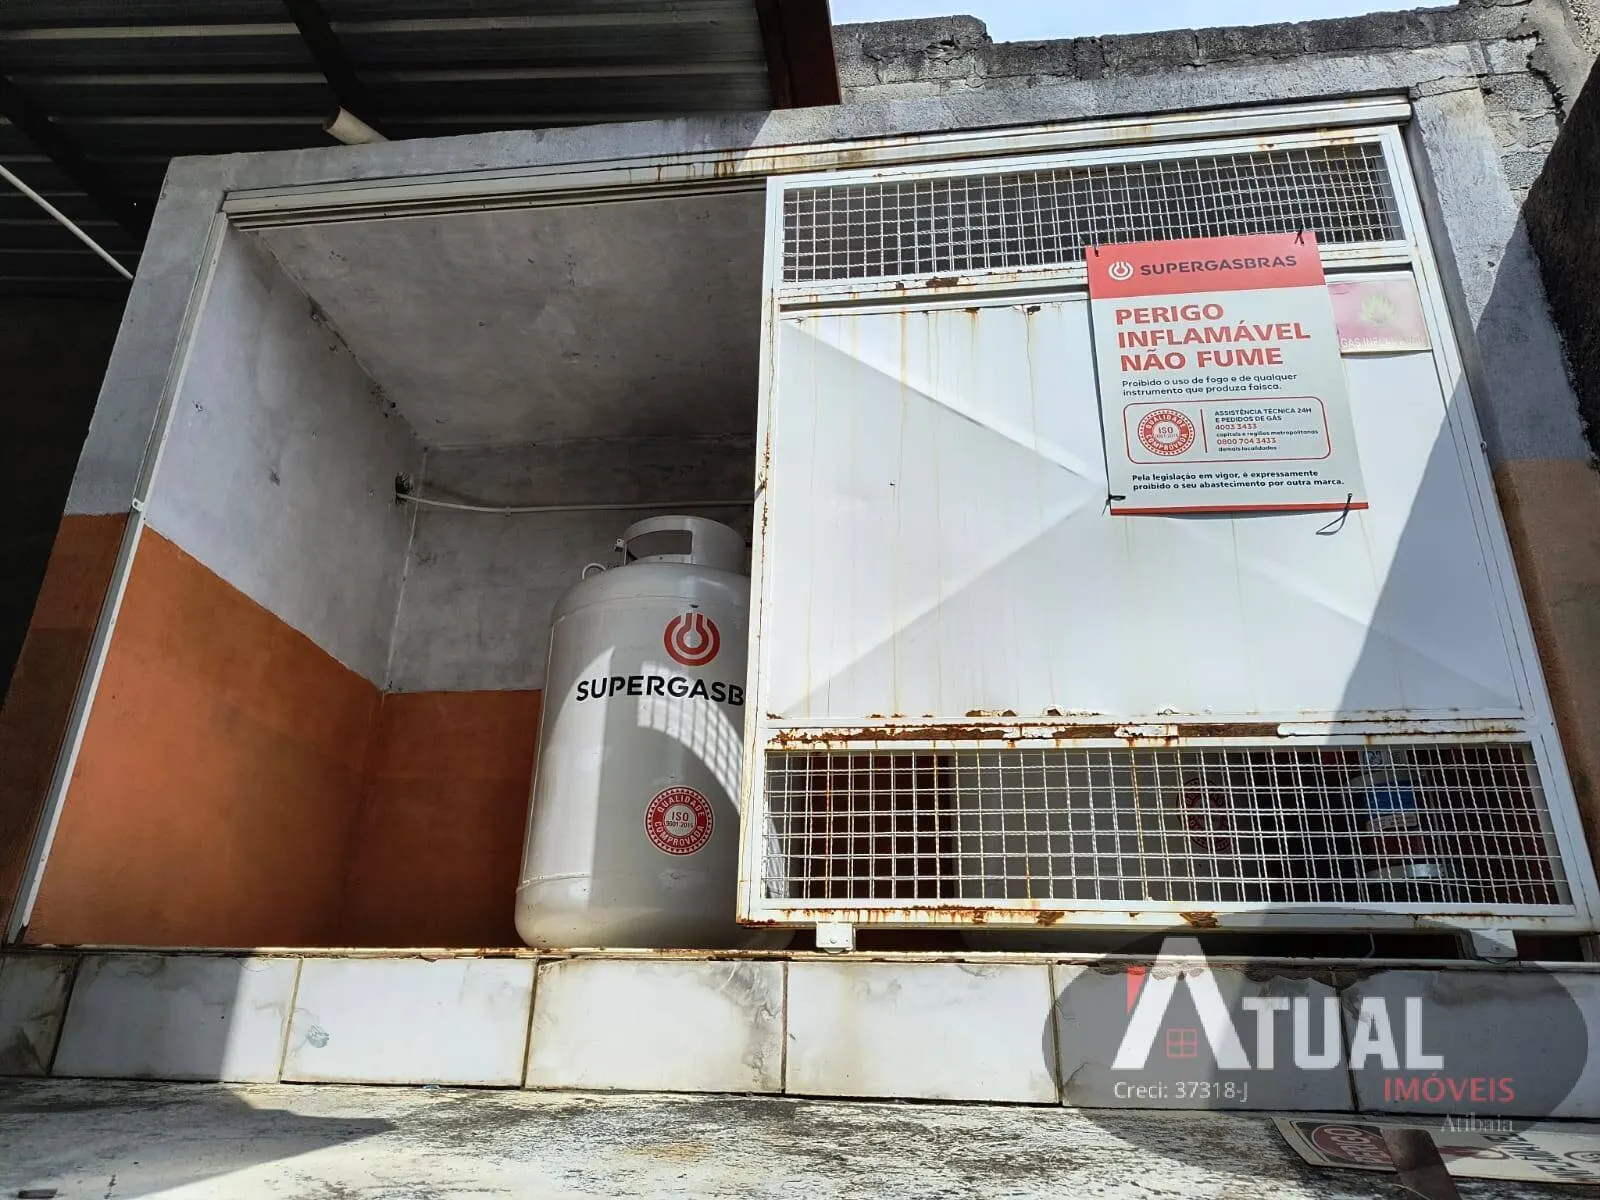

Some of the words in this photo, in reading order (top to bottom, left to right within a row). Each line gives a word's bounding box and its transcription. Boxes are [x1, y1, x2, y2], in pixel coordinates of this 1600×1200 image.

[1140, 255, 1297, 276] SUPERGASBRAS
[1115, 303, 1224, 325] PERIGO
[1118, 320, 1311, 348] INFLAMÁVEL
[1120, 348, 1186, 372] NÃO
[1197, 348, 1283, 368] FUME
[1122, 378, 1162, 388] Proibido
[1191, 376, 1204, 384] de
[1205, 375, 1229, 385] fogo
[1239, 374, 1252, 382] de
[1253, 373, 1298, 382] qualquer
[1123, 388, 1183, 397] instrumento
[1185, 386, 1204, 395] que
[1205, 384, 1247, 394] produza
[1214, 407, 1262, 416] ASSISTÊNCIA
[1264, 406, 1296, 414] TÉCNICA
[1158, 426, 1174, 434] ISO
[1132, 473, 1151, 481] Pela
[1152, 472, 1197, 482] legislação
[1215, 471, 1240, 480] vigor,
[1250, 469, 1318, 479] expressamente
[1133, 482, 1171, 492] proibido
[1199, 480, 1266, 489] abastecimento
[1268, 480, 1285, 488] por
[1313, 478, 1345, 486] marca.
[576, 675, 744, 707] SUPERGASB
[656, 794, 706, 817] QUALIDADE
[671, 811, 689, 822] ISO
[654, 821, 705, 847] COMPROVADA
[1323, 1127, 1394, 1164] PERIGO
